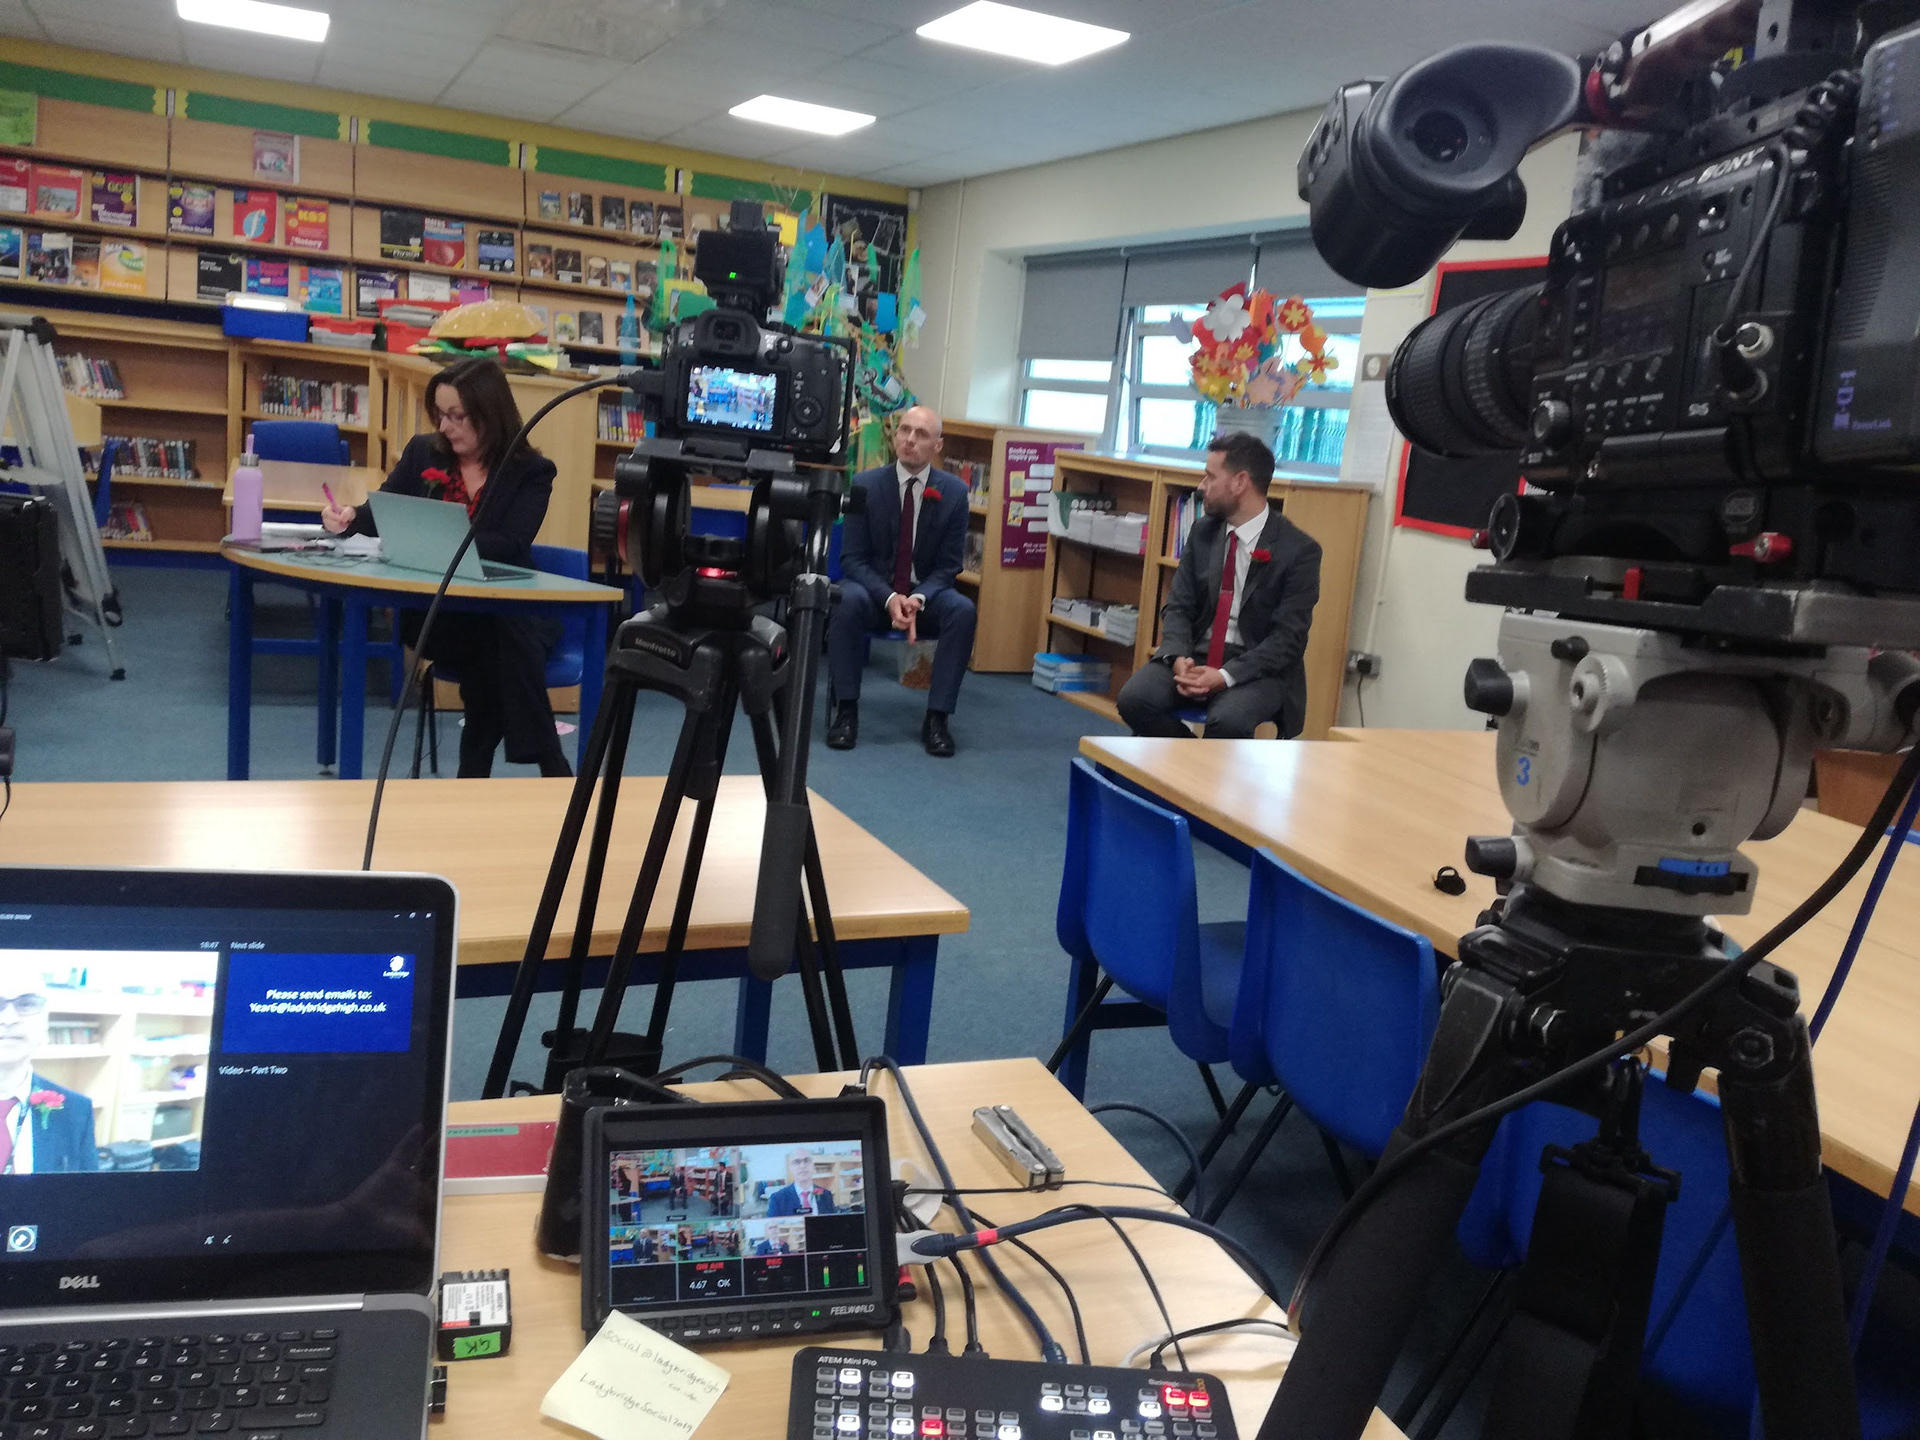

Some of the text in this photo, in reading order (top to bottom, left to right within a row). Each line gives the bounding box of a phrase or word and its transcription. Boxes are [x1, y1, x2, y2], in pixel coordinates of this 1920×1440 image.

[1697, 146, 1765, 184] SONY
[634, 637, 677, 658] Manfrotto
[266, 989, 372, 1000] Please send emails to:
[218, 1066, 244, 1075] Video
[251, 1066, 269, 1075] Part
[269, 1066, 289, 1075] Two
[59, 1275, 101, 1289] DELL
[830, 1304, 875, 1316] FEELWORLD
[817, 1355, 878, 1367] ATEM Mini Pro
